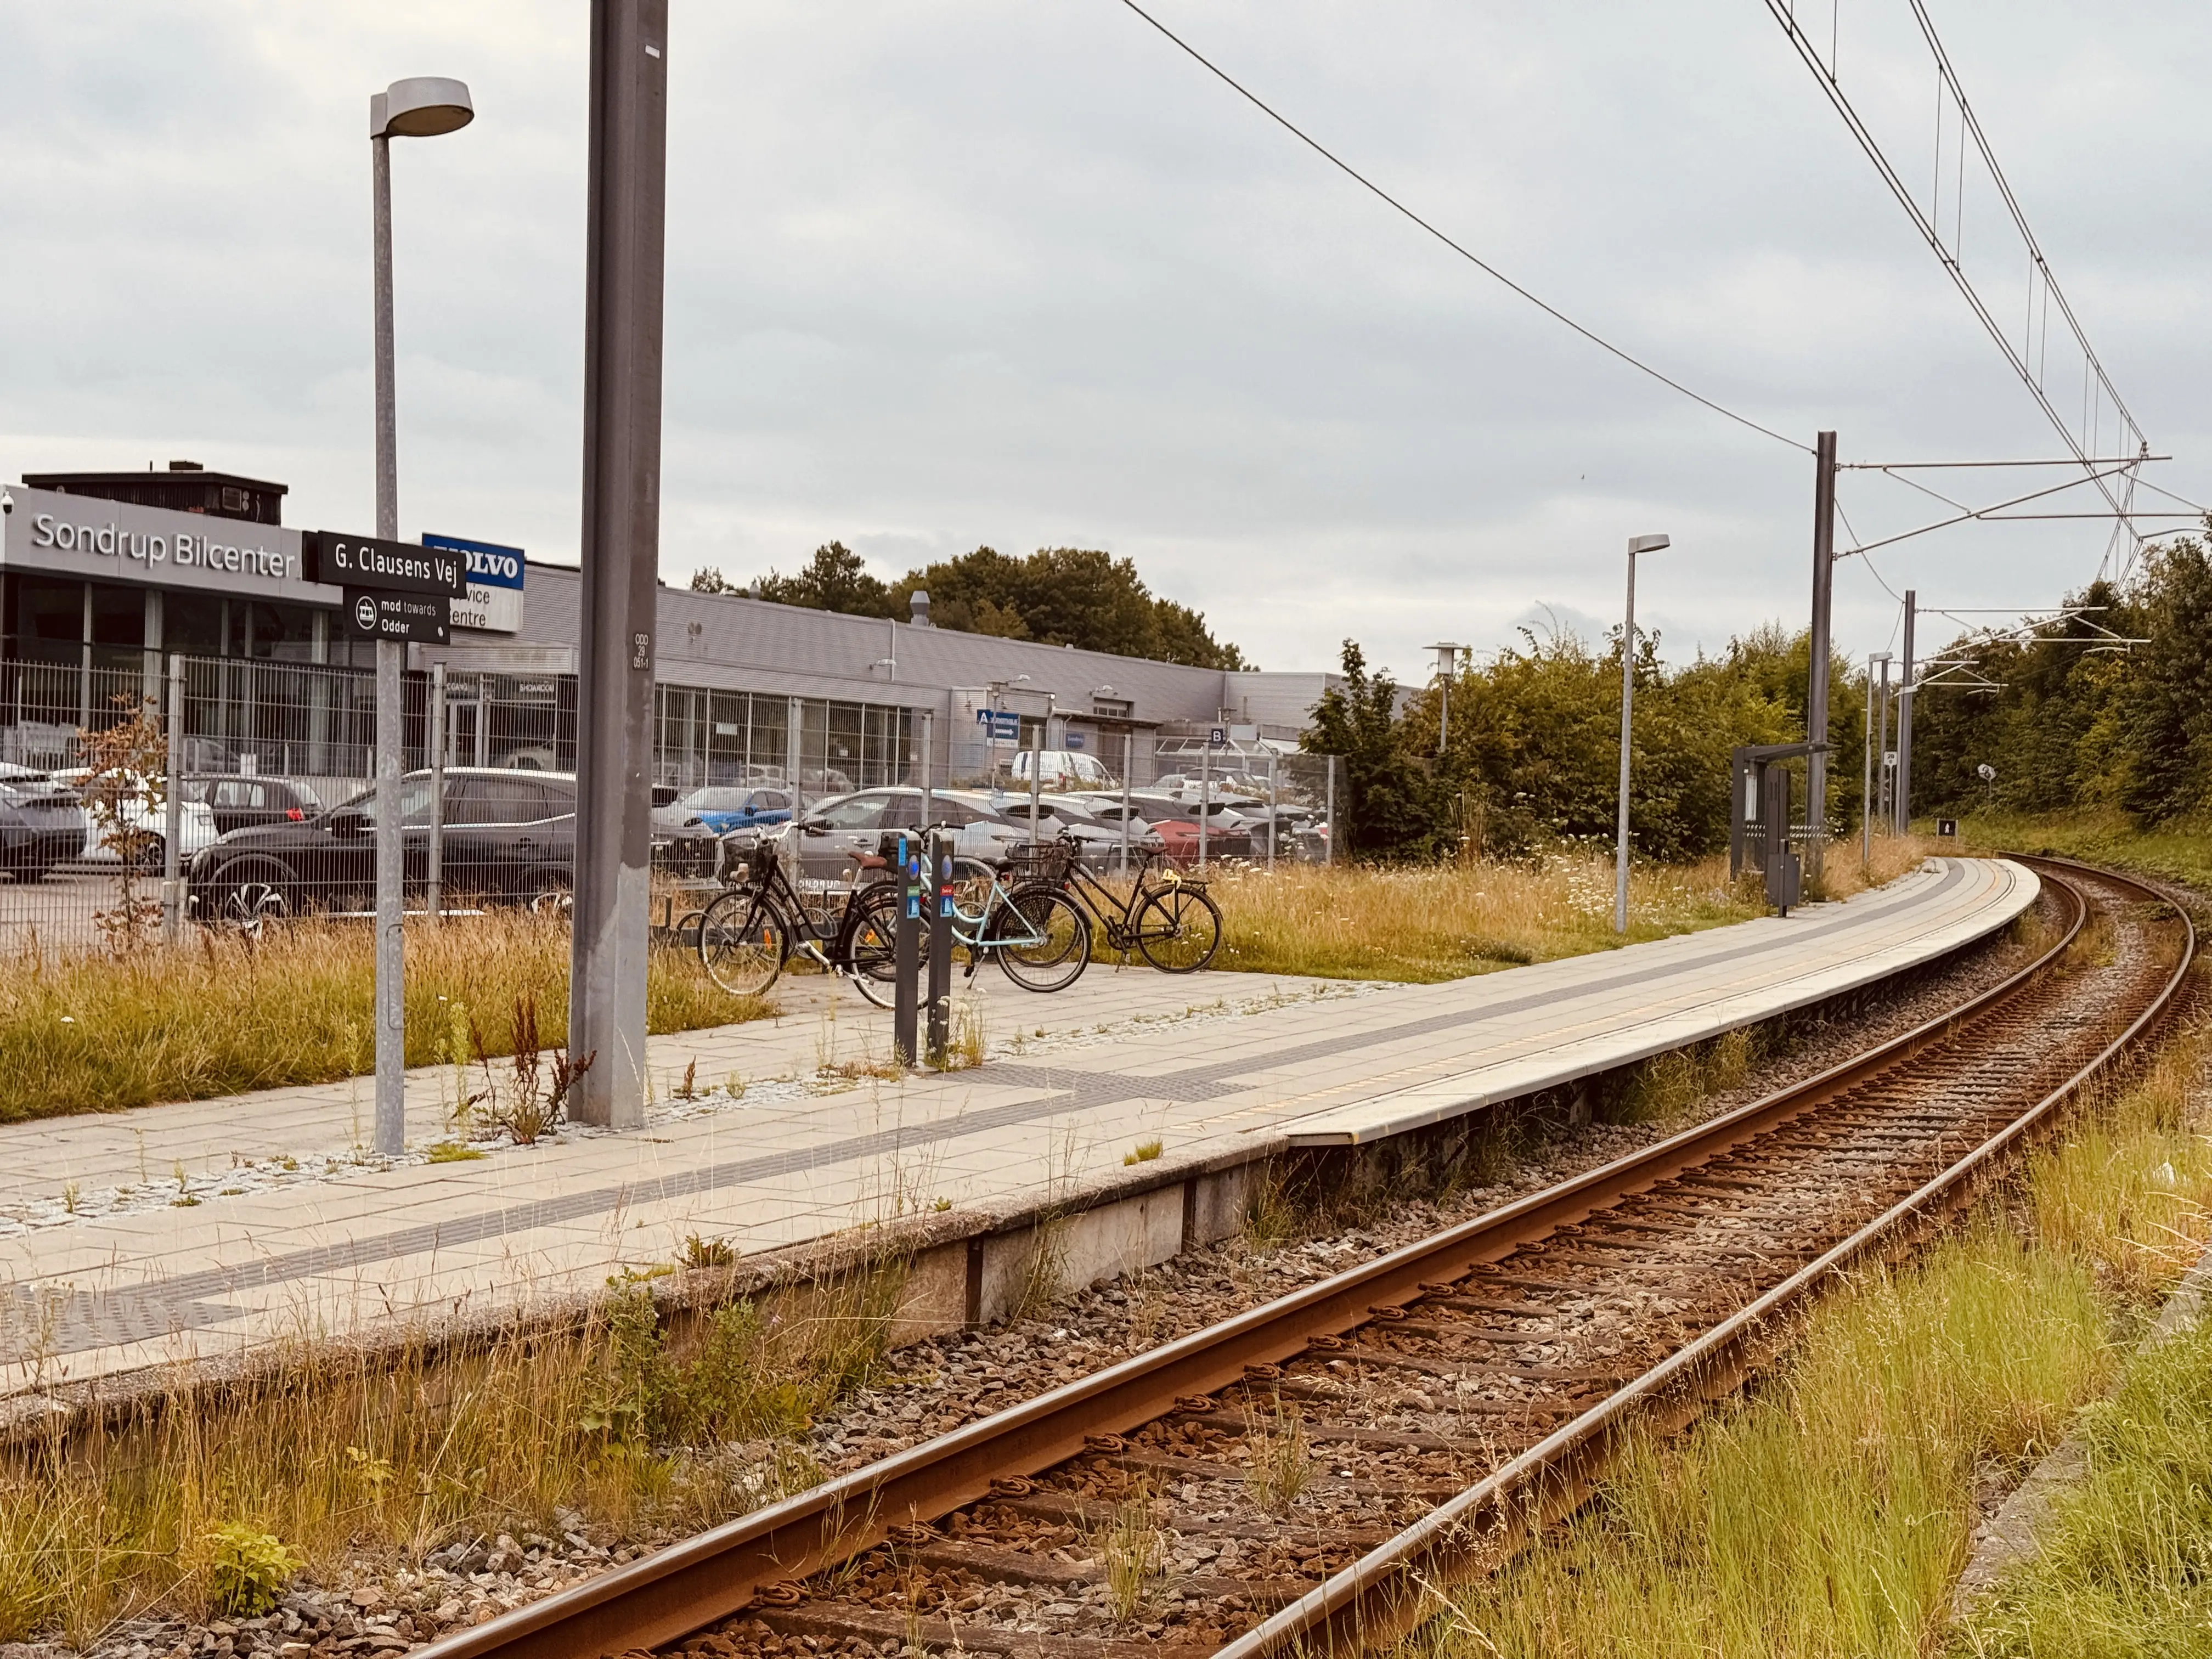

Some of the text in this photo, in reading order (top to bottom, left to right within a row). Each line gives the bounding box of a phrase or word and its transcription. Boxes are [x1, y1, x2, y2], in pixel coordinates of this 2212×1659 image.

[35, 514, 295, 578] Sondrup Bilcenter
[335, 543, 457, 589] G. Clausens Vej
[434, 546, 518, 579] OLVO
[458, 584, 490, 604] vice
[381, 599, 436, 617] mod towards
[382, 618, 410, 634] Odder
[450, 608, 486, 627] entre
[635, 633, 648, 645] ODD
[638, 645, 645, 657] 29
[979, 712, 988, 725] A
[1213, 731, 1221, 742] B
